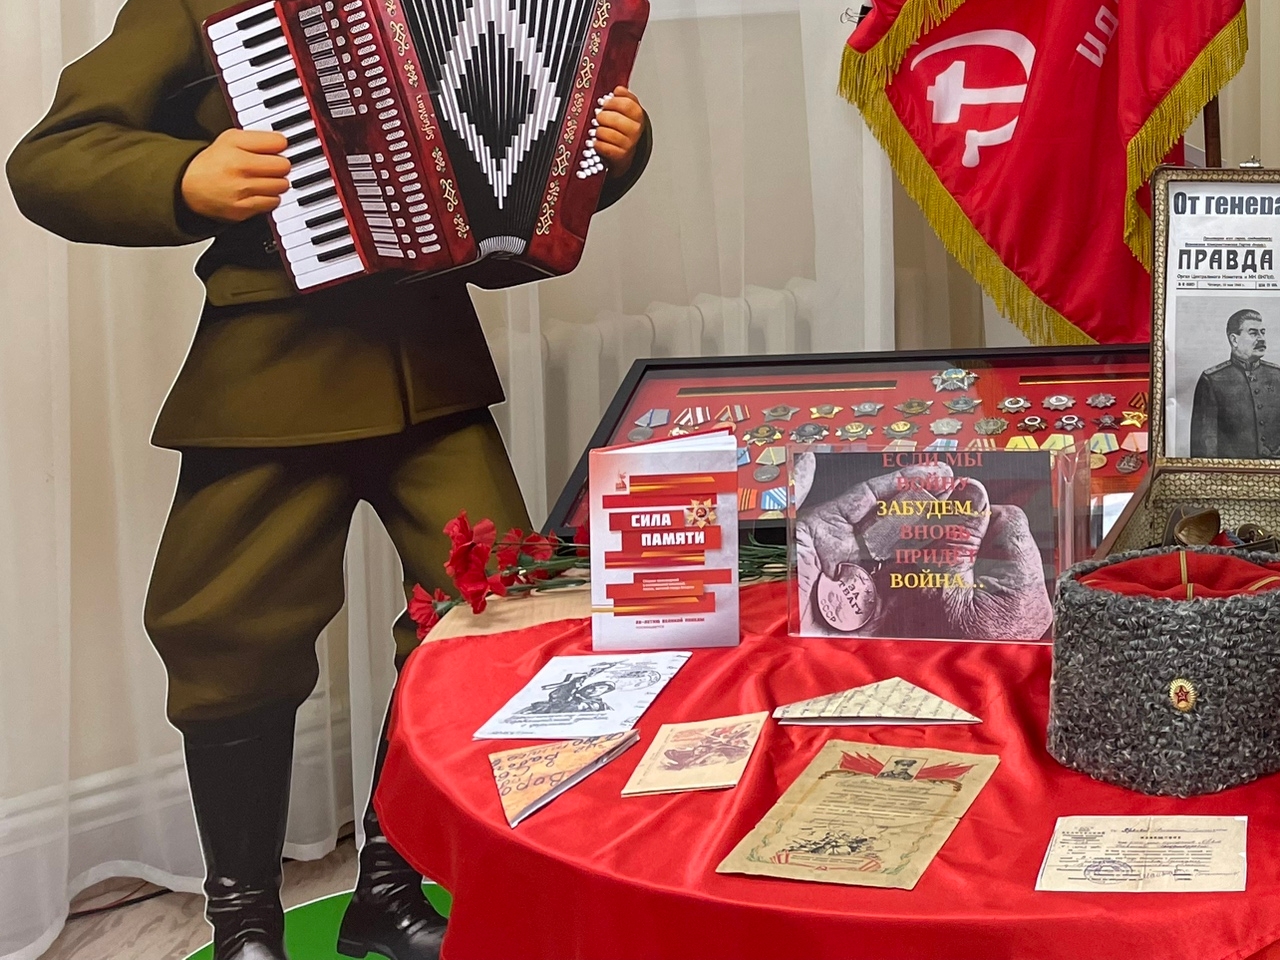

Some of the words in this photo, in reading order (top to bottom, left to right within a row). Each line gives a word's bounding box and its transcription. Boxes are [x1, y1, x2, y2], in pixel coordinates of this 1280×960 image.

[1173, 191, 1200, 215] От
[1178, 249, 1273, 273] ПРАВДА
[882, 452, 940, 468] ЕСЛИ
[945, 452, 983, 467] МЫ
[896, 471, 970, 492] ВОЙНУ
[631, 513, 672, 528] СИЛА
[641, 531, 705, 546] ПАМЯТИ
[899, 524, 972, 540] ВНОВЬ
[838, 580, 863, 615] ТВАГУ
[821, 598, 837, 622] СССР
